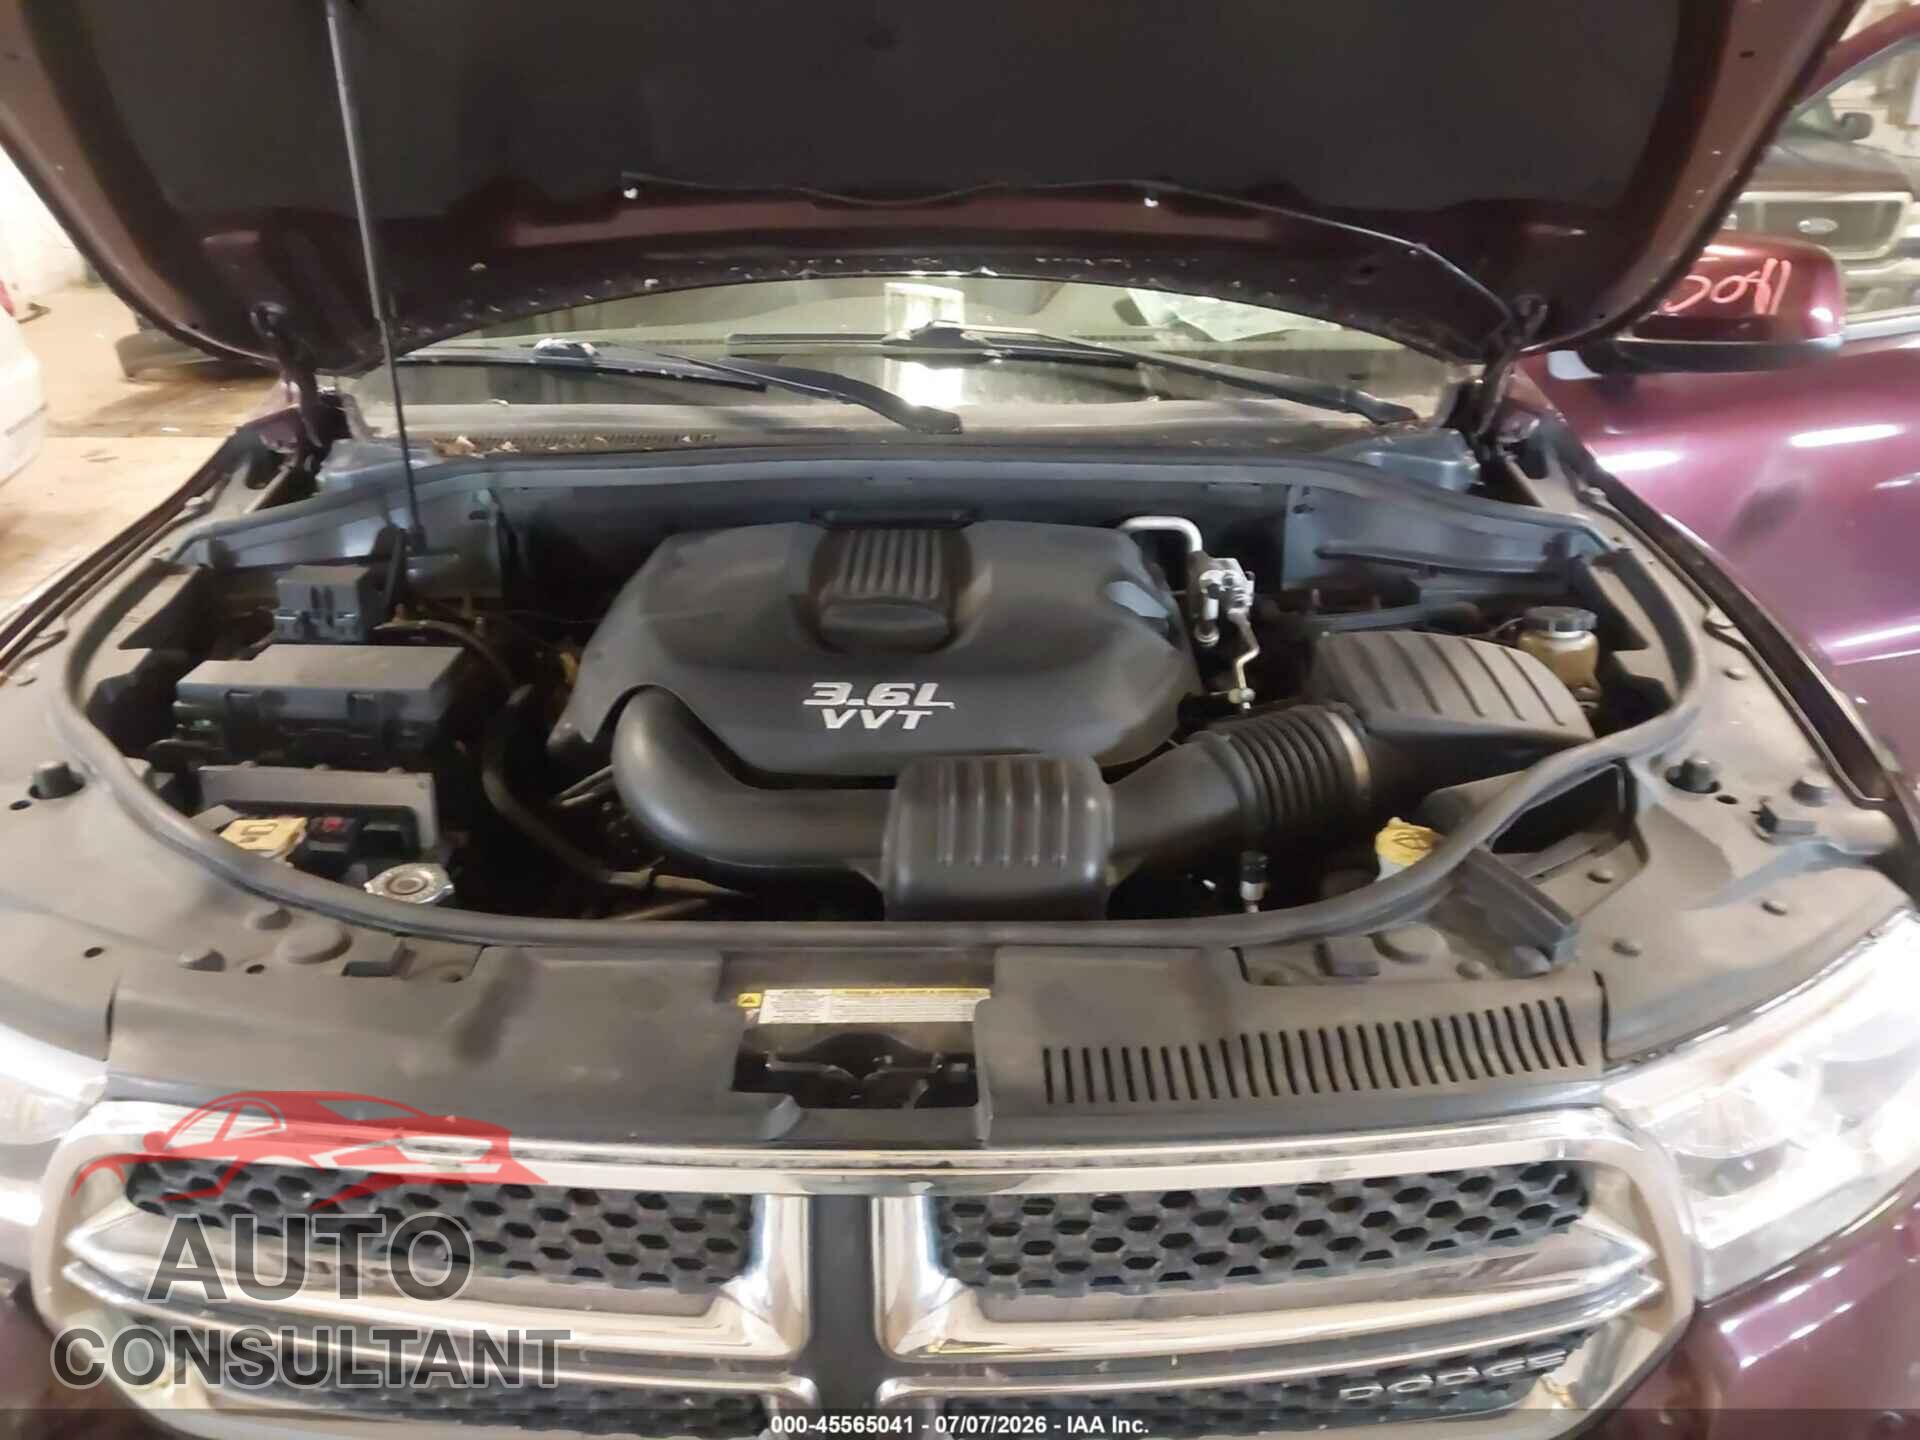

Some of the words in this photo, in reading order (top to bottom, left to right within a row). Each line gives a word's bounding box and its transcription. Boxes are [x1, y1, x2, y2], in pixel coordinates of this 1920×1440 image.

[802, 682, 956, 709] 3.6L
[822, 708, 933, 729] VVT
[1339, 1349, 1567, 1401] DODGE
